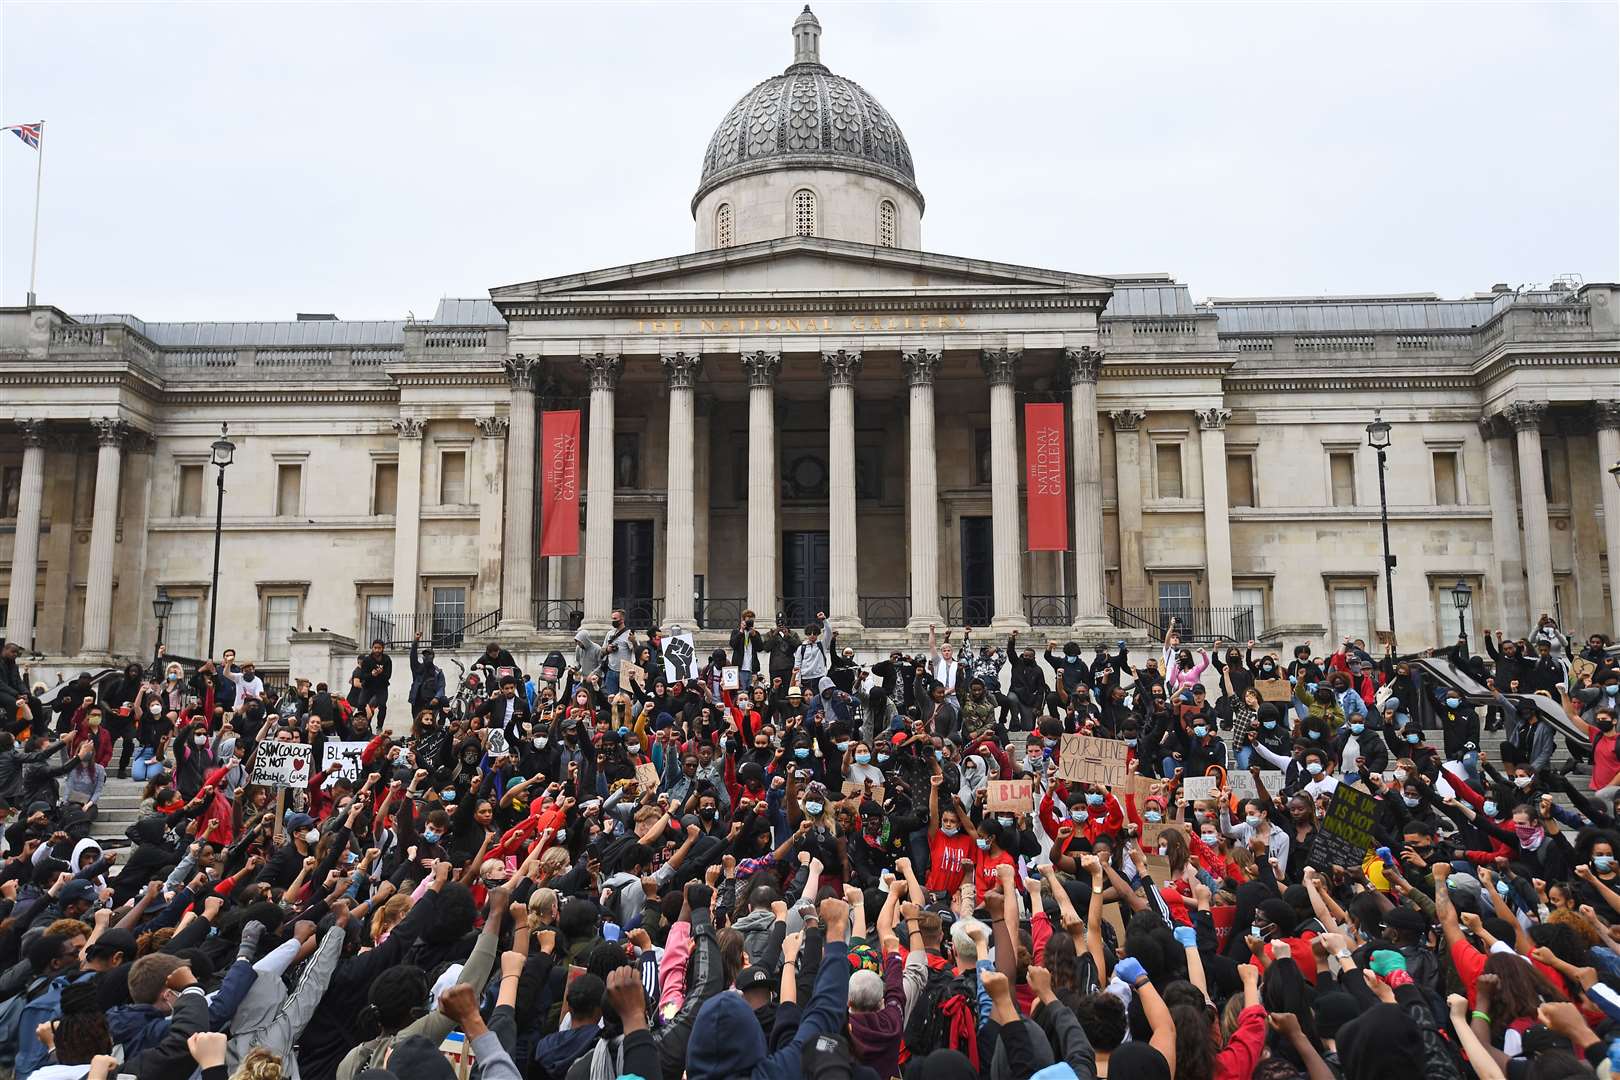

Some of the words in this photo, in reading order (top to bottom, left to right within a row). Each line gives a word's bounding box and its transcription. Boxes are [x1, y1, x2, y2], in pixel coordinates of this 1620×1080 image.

[637, 318, 683, 333] THE
[700, 316, 833, 332] NATIONAL
[851, 314, 968, 331] GALLERY
[554, 433, 564, 503] NATIONAL
[563, 433, 576, 501] GALLERY
[1037, 427, 1049, 495] NATIONAL
[1048, 427, 1062, 496] GALLERY
[1062, 734, 1091, 757] YOUR
[255, 757, 267, 768] IS
[269, 757, 287, 768] NOT
[1062, 757, 1127, 787] VIOLENCE
[1000, 784, 1031, 801] BLM
[1227, 775, 1248, 789] WE
[1338, 785, 1359, 806] THE
[1360, 798, 1377, 815] UK
[1334, 803, 1349, 819] IS
[1350, 810, 1377, 831] NOT
